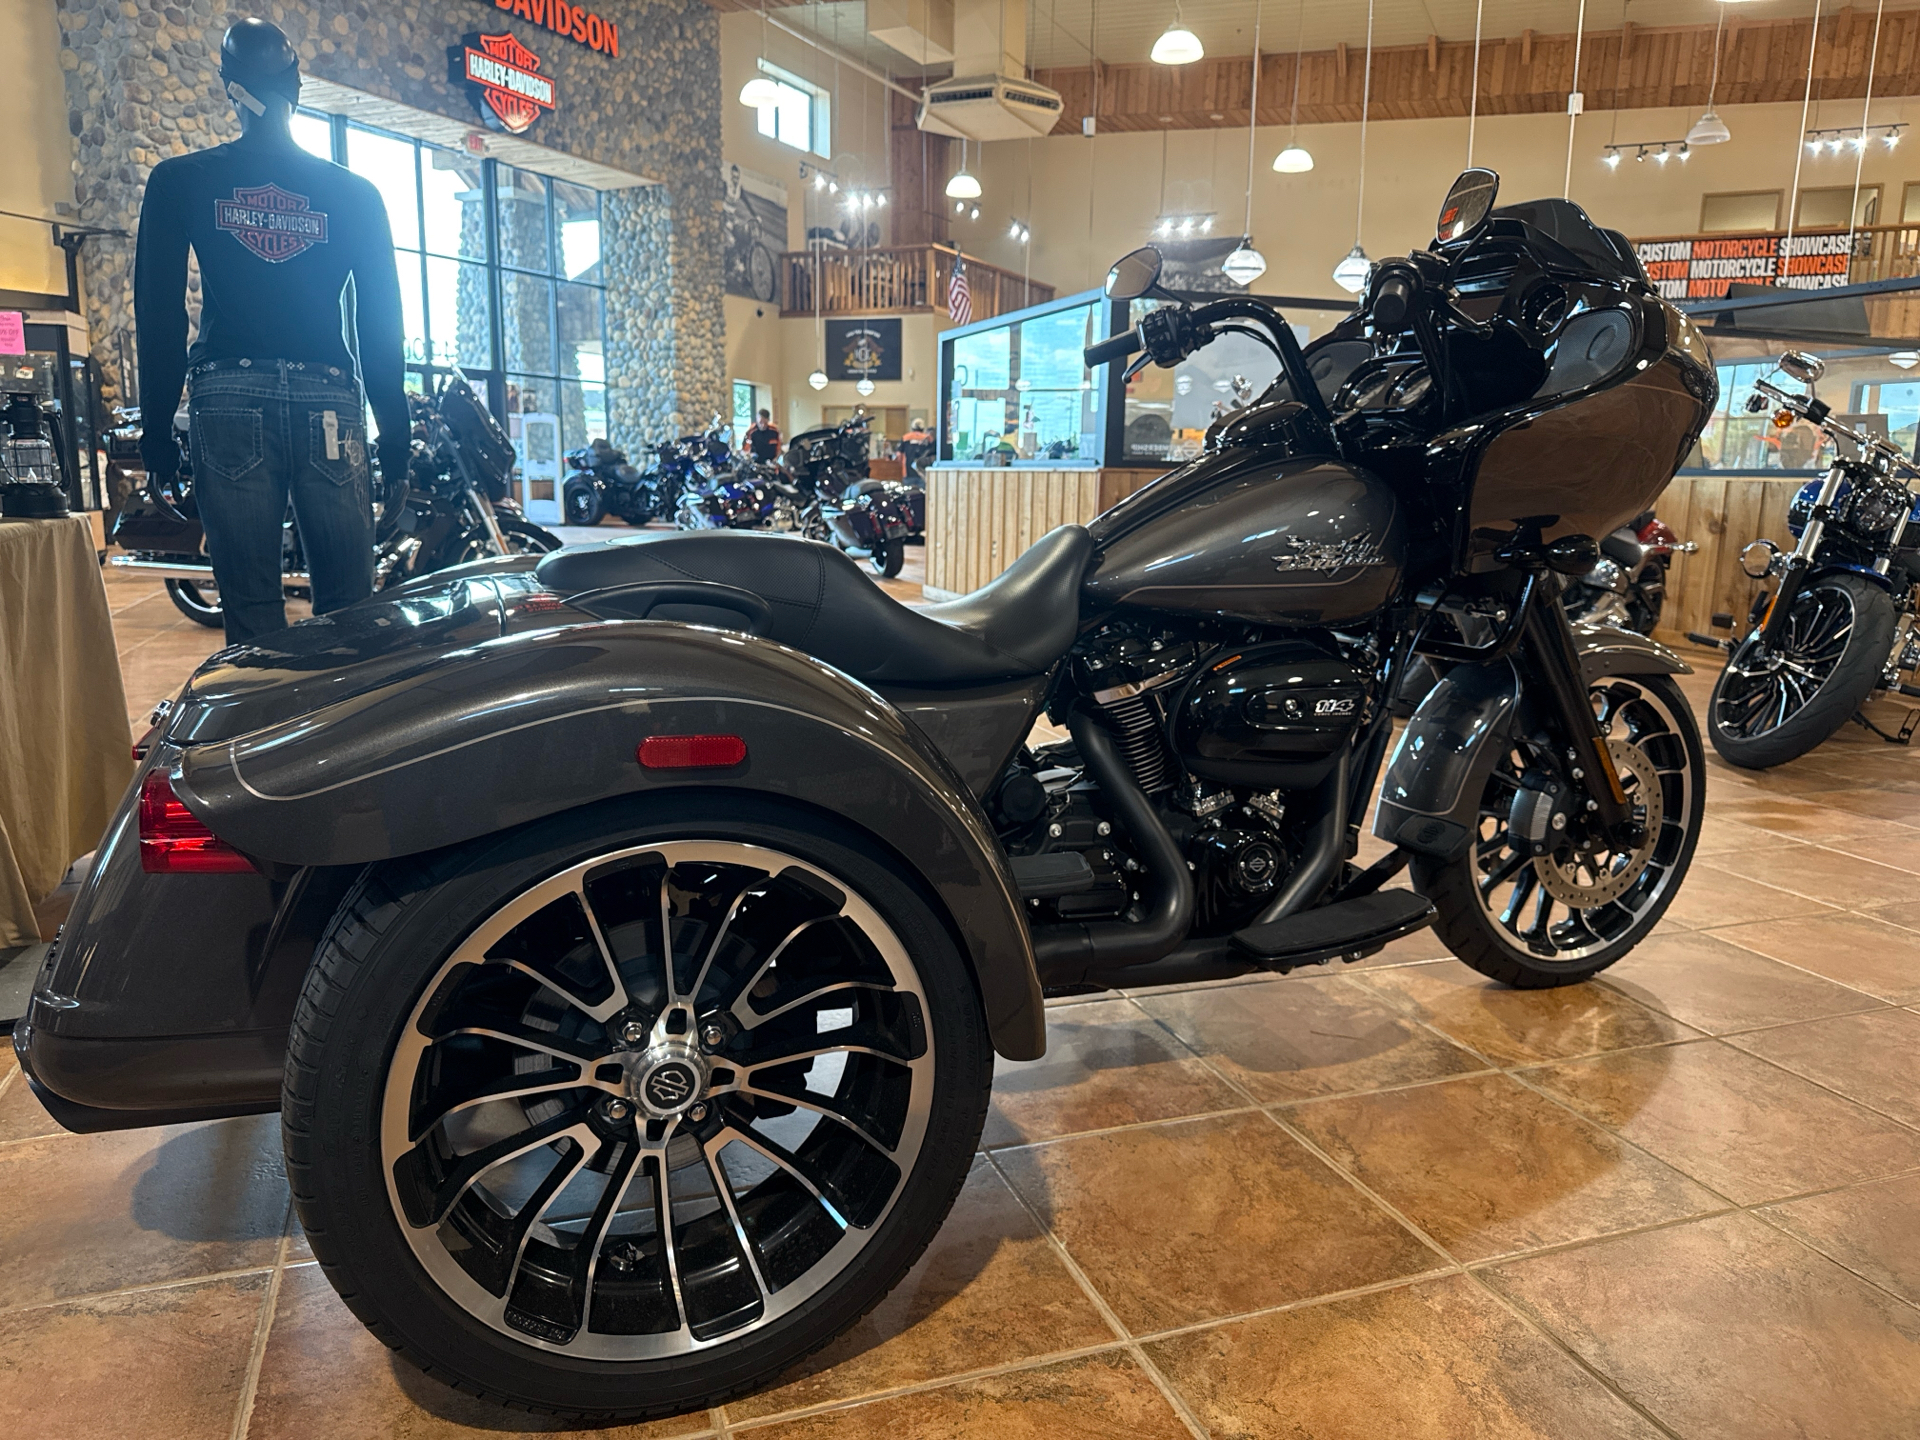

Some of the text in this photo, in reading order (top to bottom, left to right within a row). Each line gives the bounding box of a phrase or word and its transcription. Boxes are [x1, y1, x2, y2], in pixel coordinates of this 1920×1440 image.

[489, 41, 534, 71] MOTOR
[469, 54, 552, 104] HARLEY-DAVIDSON
[247, 191, 299, 211] MOTOR
[224, 207, 320, 234] HARLEY-DAVIDSON
[247, 231, 298, 255] CYCLES
[1640, 235, 1852, 261] CUSTOM MOTORCYCLE SHOWCASE
[1690, 258, 1777, 279] MOTORCYCLE
[1654, 279, 1687, 299] TOM
[1314, 698, 1356, 713] 114
